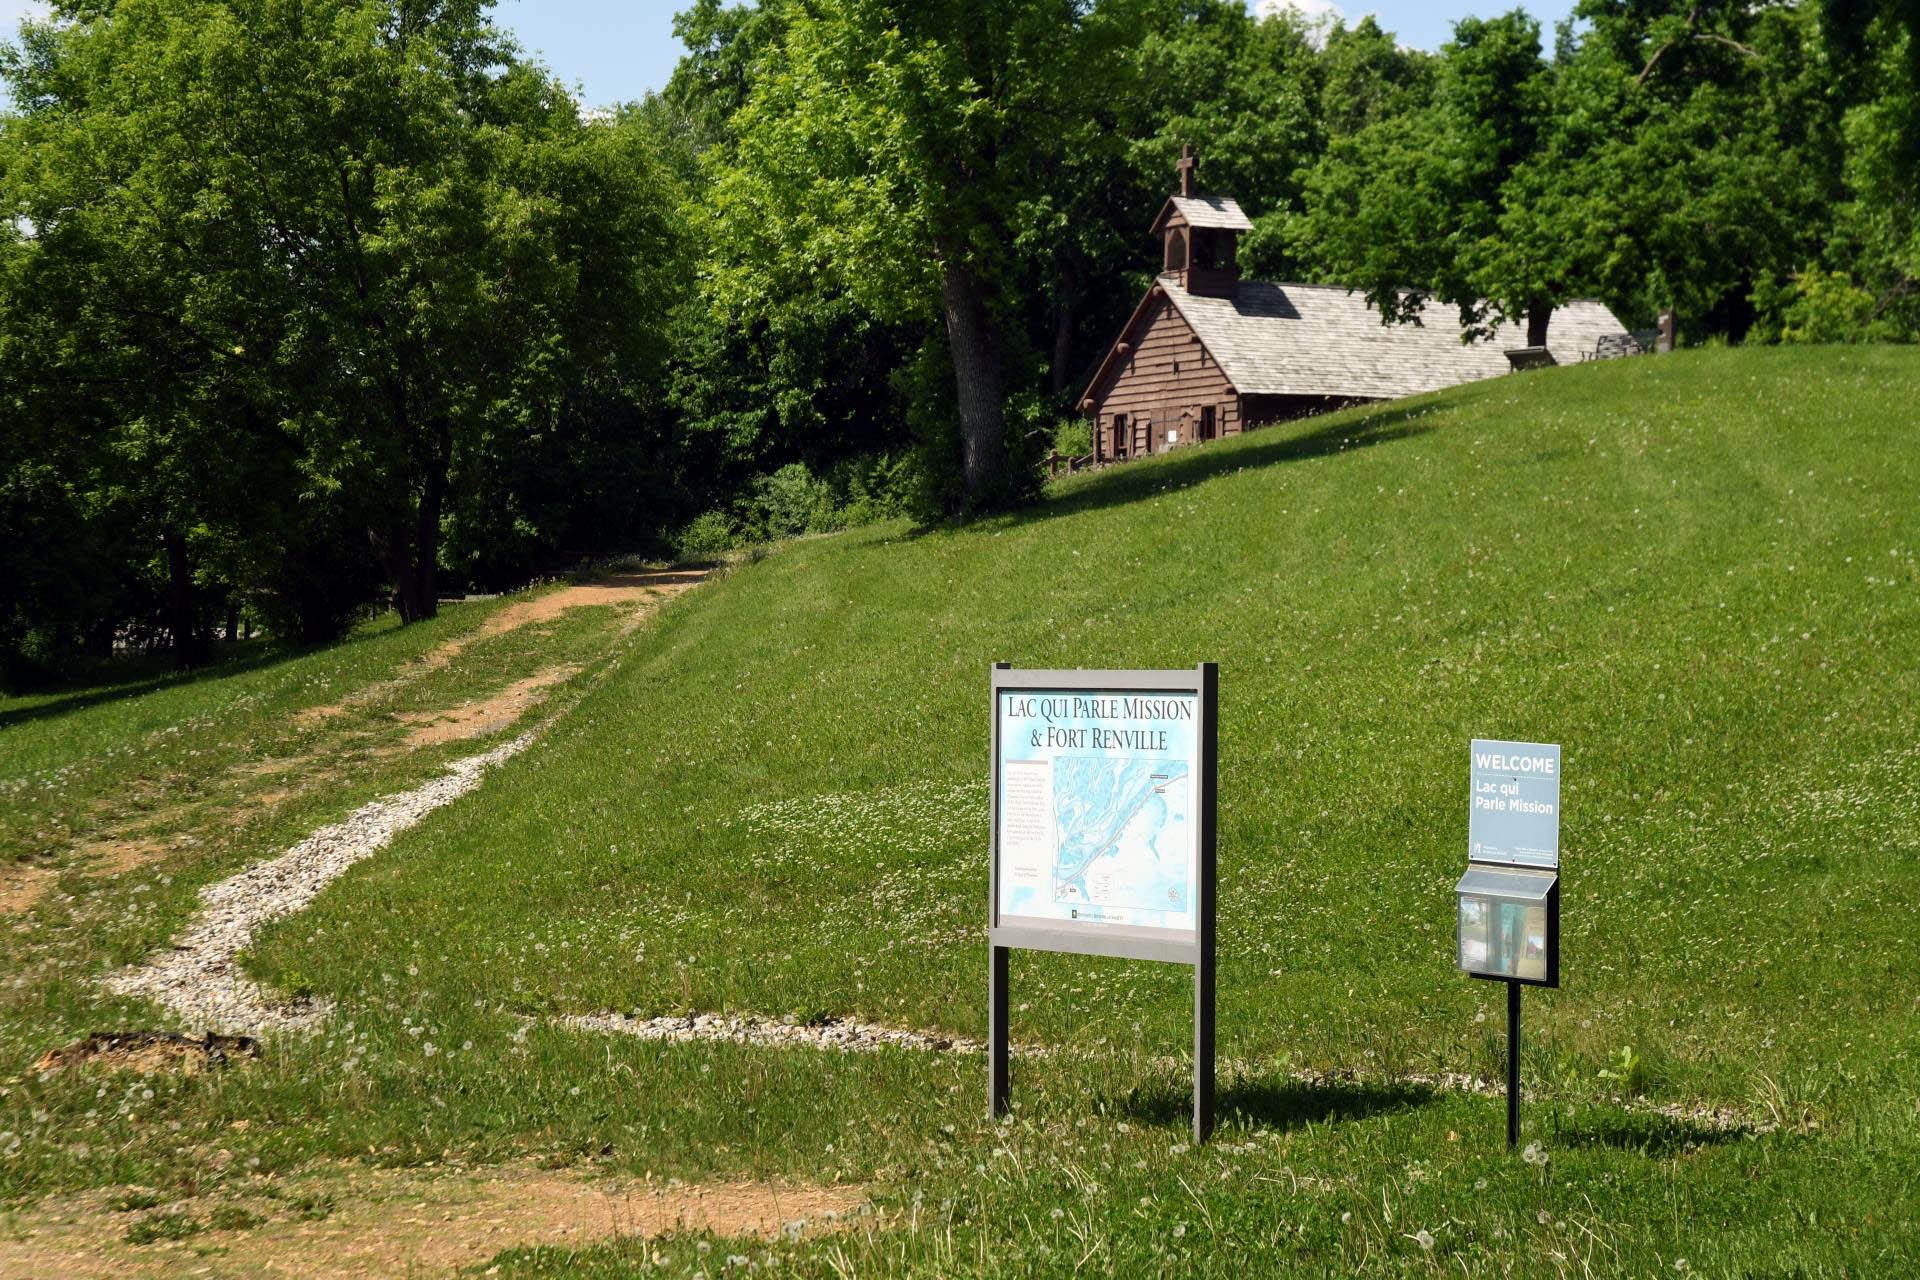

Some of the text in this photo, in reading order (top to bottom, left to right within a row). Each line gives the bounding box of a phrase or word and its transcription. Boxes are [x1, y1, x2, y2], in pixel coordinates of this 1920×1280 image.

[1008, 697, 1192, 723] LAC QUI PARLE MISSION
[1031, 727, 1168, 750] & FORT RENVILLE
[1476, 753, 1554, 774] WELCOME
[1476, 780, 1519, 797] Lac qui
[1475, 796, 1553, 814] Parle Mission
